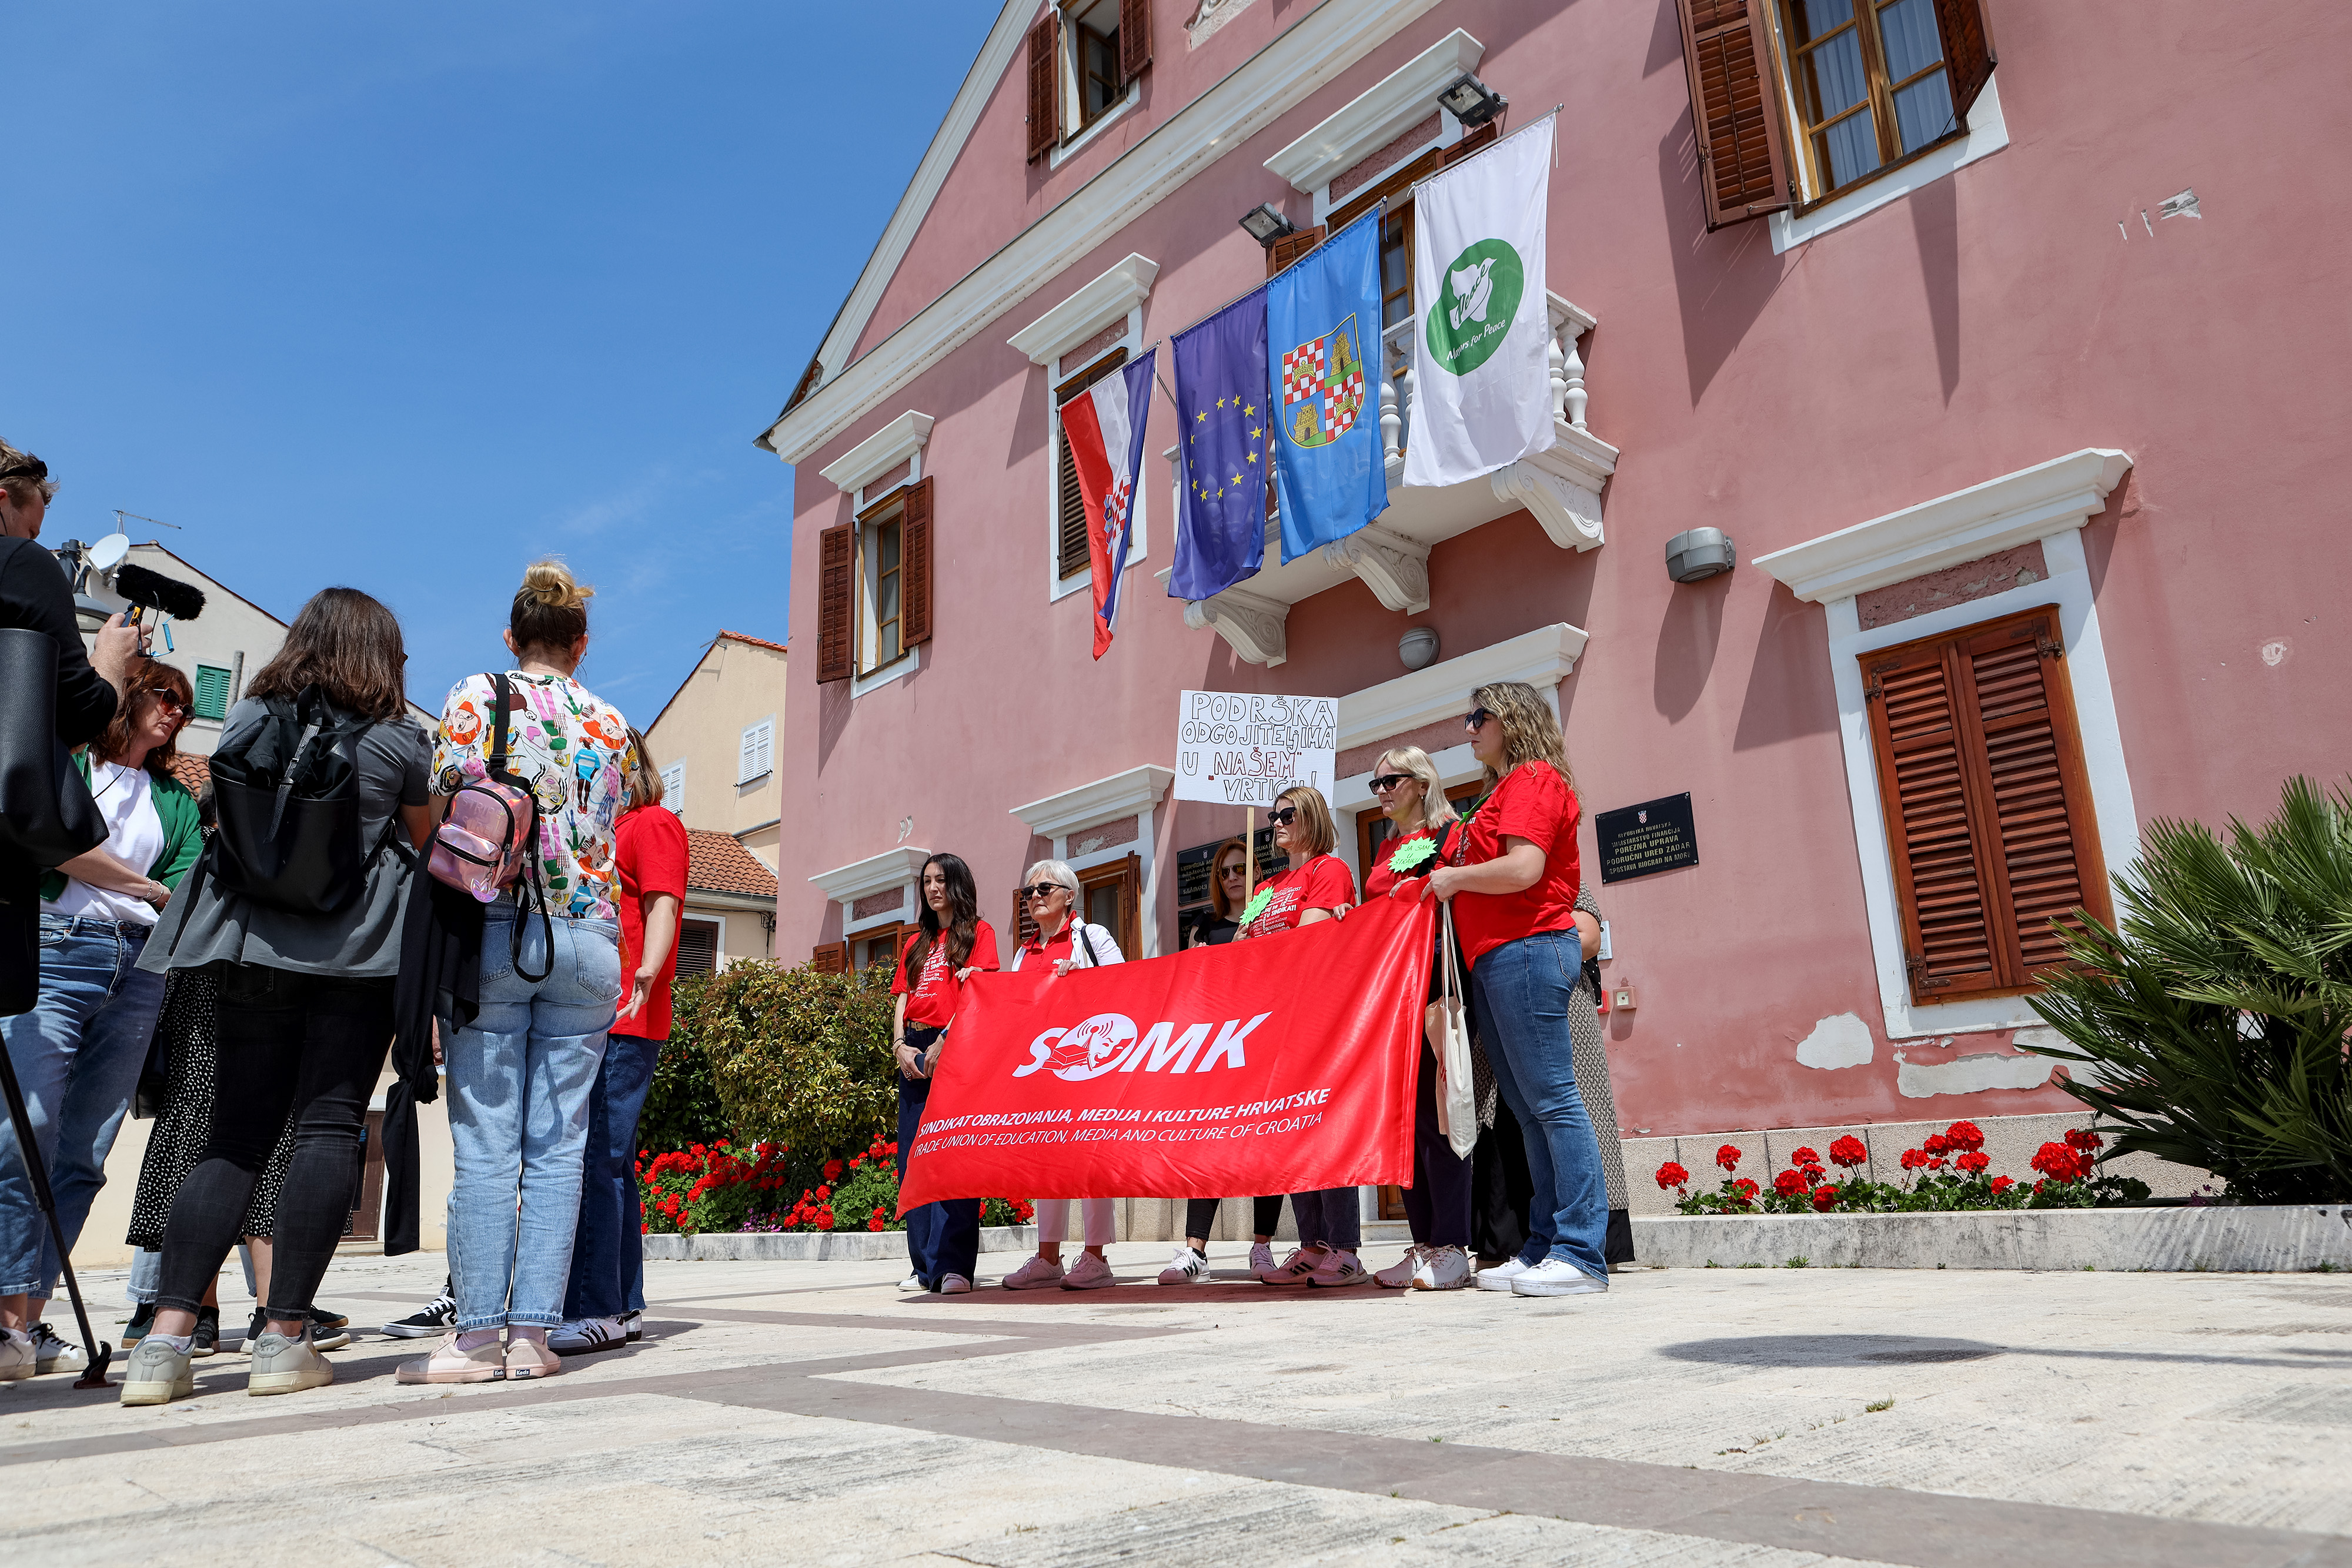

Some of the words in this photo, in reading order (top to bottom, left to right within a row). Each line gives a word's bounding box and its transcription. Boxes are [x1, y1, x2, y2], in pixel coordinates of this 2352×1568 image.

[1446, 340, 1469, 360] Mayors
[1471, 333, 1482, 346] for
[1484, 319, 1505, 337] Peace
[1192, 693, 1335, 727] PODRŠKA
[1182, 752, 1198, 775] U
[1611, 834, 1650, 848] MINISTARSTVO
[1652, 827, 1681, 838] FINANCIJA
[1646, 821, 1672, 832] HRVATSKA
[1606, 852, 1642, 865] PODRUČNI
[1645, 847, 1664, 858] URED
[1666, 842, 1690, 853] ZADAR
[1615, 842, 1647, 855] POREZNA
[1649, 835, 1679, 847] UPRAVA
[1638, 857, 1663, 868] BIOGRAD
[1012, 1011, 1273, 1082] SOMK
[918, 1115, 974, 1138] SINDIKAT
[971, 1109, 1074, 1126] OBRAZOVANJA,
[1077, 1108, 1142, 1122] MEDIJA
[1142, 1110, 1153, 1122] I
[1151, 1105, 1235, 1122] KULTURE
[1234, 1088, 1331, 1118] HRVATSKE
[913, 1138, 943, 1158] TRADE
[941, 1134, 979, 1149] UNION
[978, 1134, 997, 1146] OF
[994, 1129, 1069, 1145] EDUCATION,
[1070, 1128, 1119, 1142] MEDIA
[1118, 1129, 1157, 1141] AND
[1158, 1126, 1230, 1141] CULTURE
[1230, 1124, 1255, 1138] OF
[1255, 1111, 1322, 1135] CROATIA
